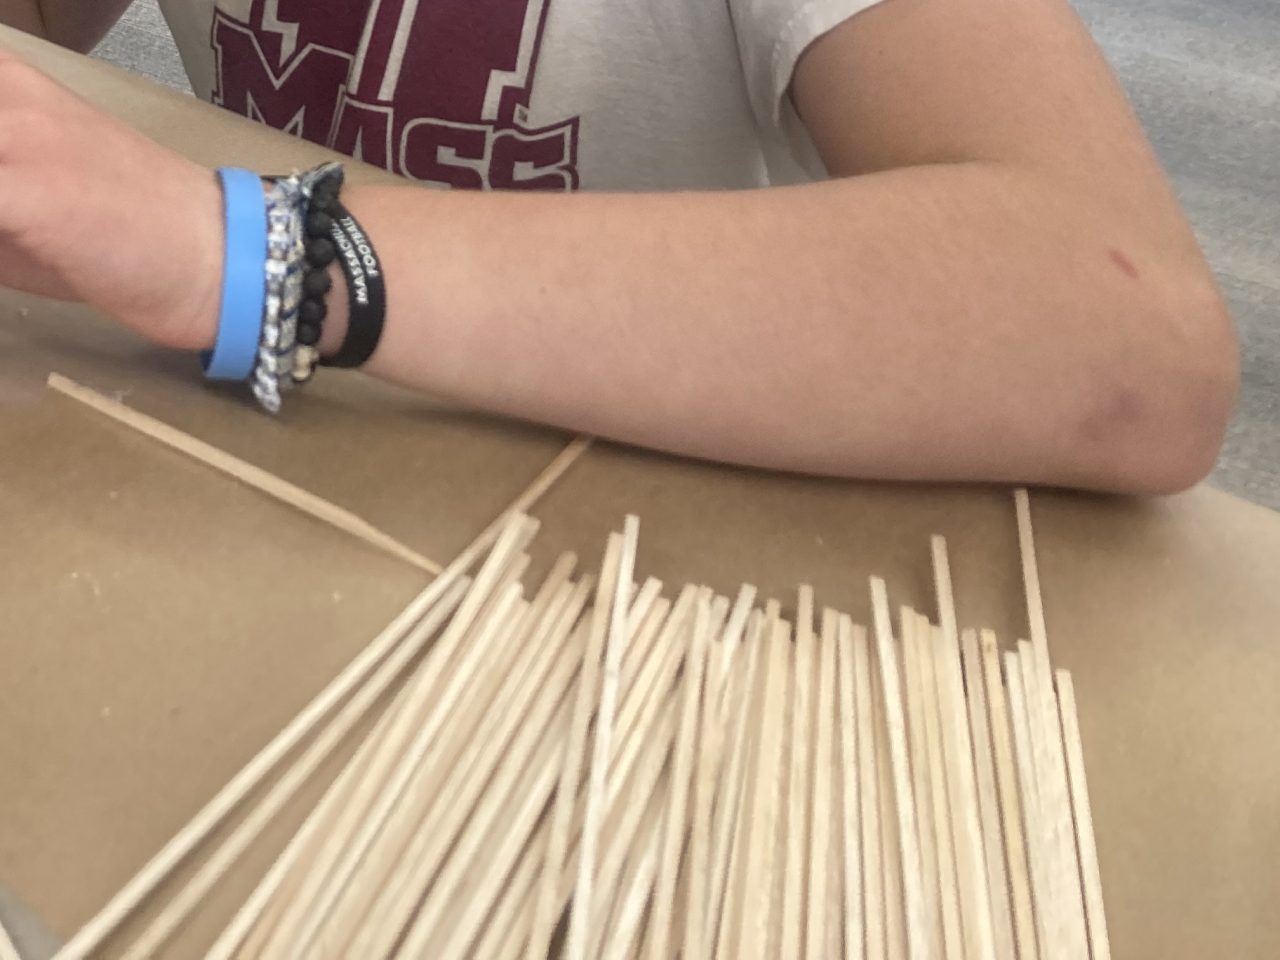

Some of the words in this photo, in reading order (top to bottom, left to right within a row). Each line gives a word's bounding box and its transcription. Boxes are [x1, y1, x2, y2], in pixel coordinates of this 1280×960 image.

[212, 7, 580, 190] MASS
[331, 220, 368, 304] MASSACHU
[341, 216, 379, 276] FOOTBALL
